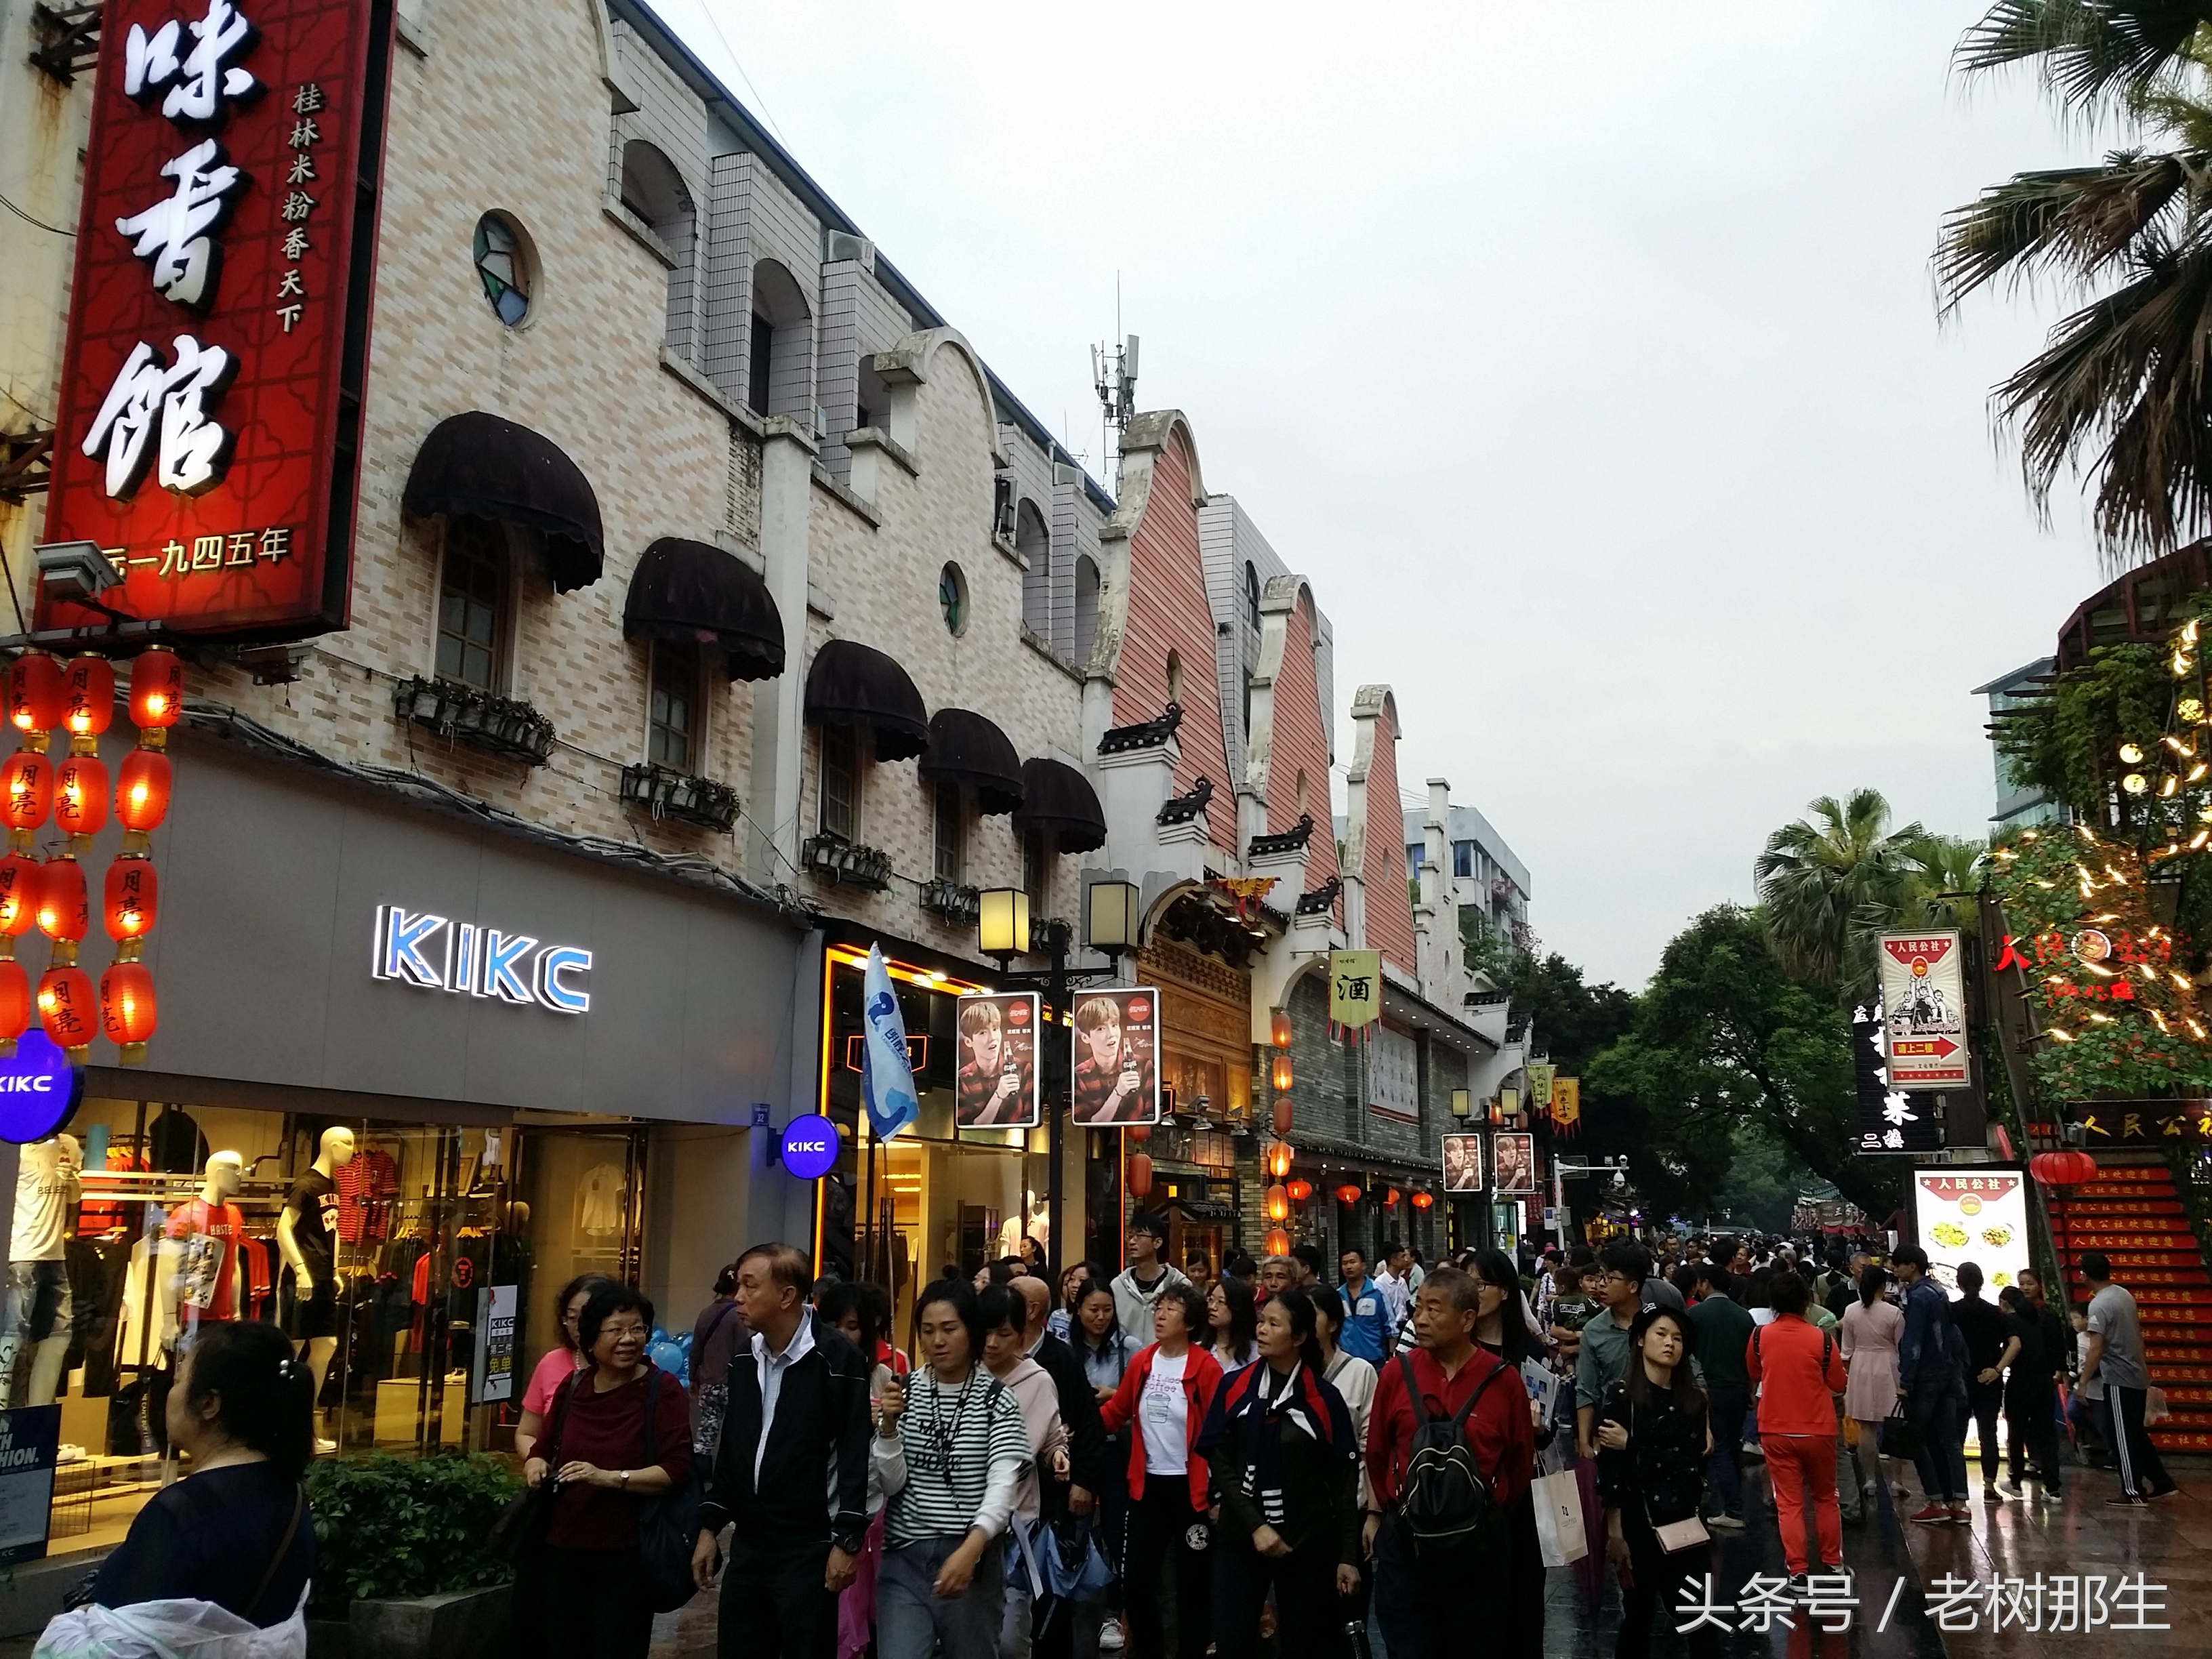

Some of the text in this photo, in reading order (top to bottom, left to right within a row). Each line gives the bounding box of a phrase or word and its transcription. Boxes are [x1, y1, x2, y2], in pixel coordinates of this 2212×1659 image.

[276, 85, 324, 333] 桂林米粉香天下
[68, 667, 92, 718] 月亮
[9, 764, 39, 816] 月亮
[56, 767, 80, 819] 月亮
[116, 869, 144, 923] 月亮
[1898, 941, 1940, 952] 人民公社
[373, 905, 592, 1014] KIKC
[1337, 974, 1372, 1002] 酒
[53, 981, 83, 1034] 月亮
[1898, 1043, 1933, 1054] 请上二楼
[787, 1141, 825, 1152] KIKC
[1938, 1178, 2001, 1190] 人民公社
[2068, 1203, 2150, 1213] 民公社欢迎您
[2070, 1219, 2169, 1230] 人民公社欢迎您
[2074, 1236, 2174, 1247] 人民公社欢迎您
[491, 1319, 514, 1328] KIKC
[489, 1356, 511, 1374] 免单
